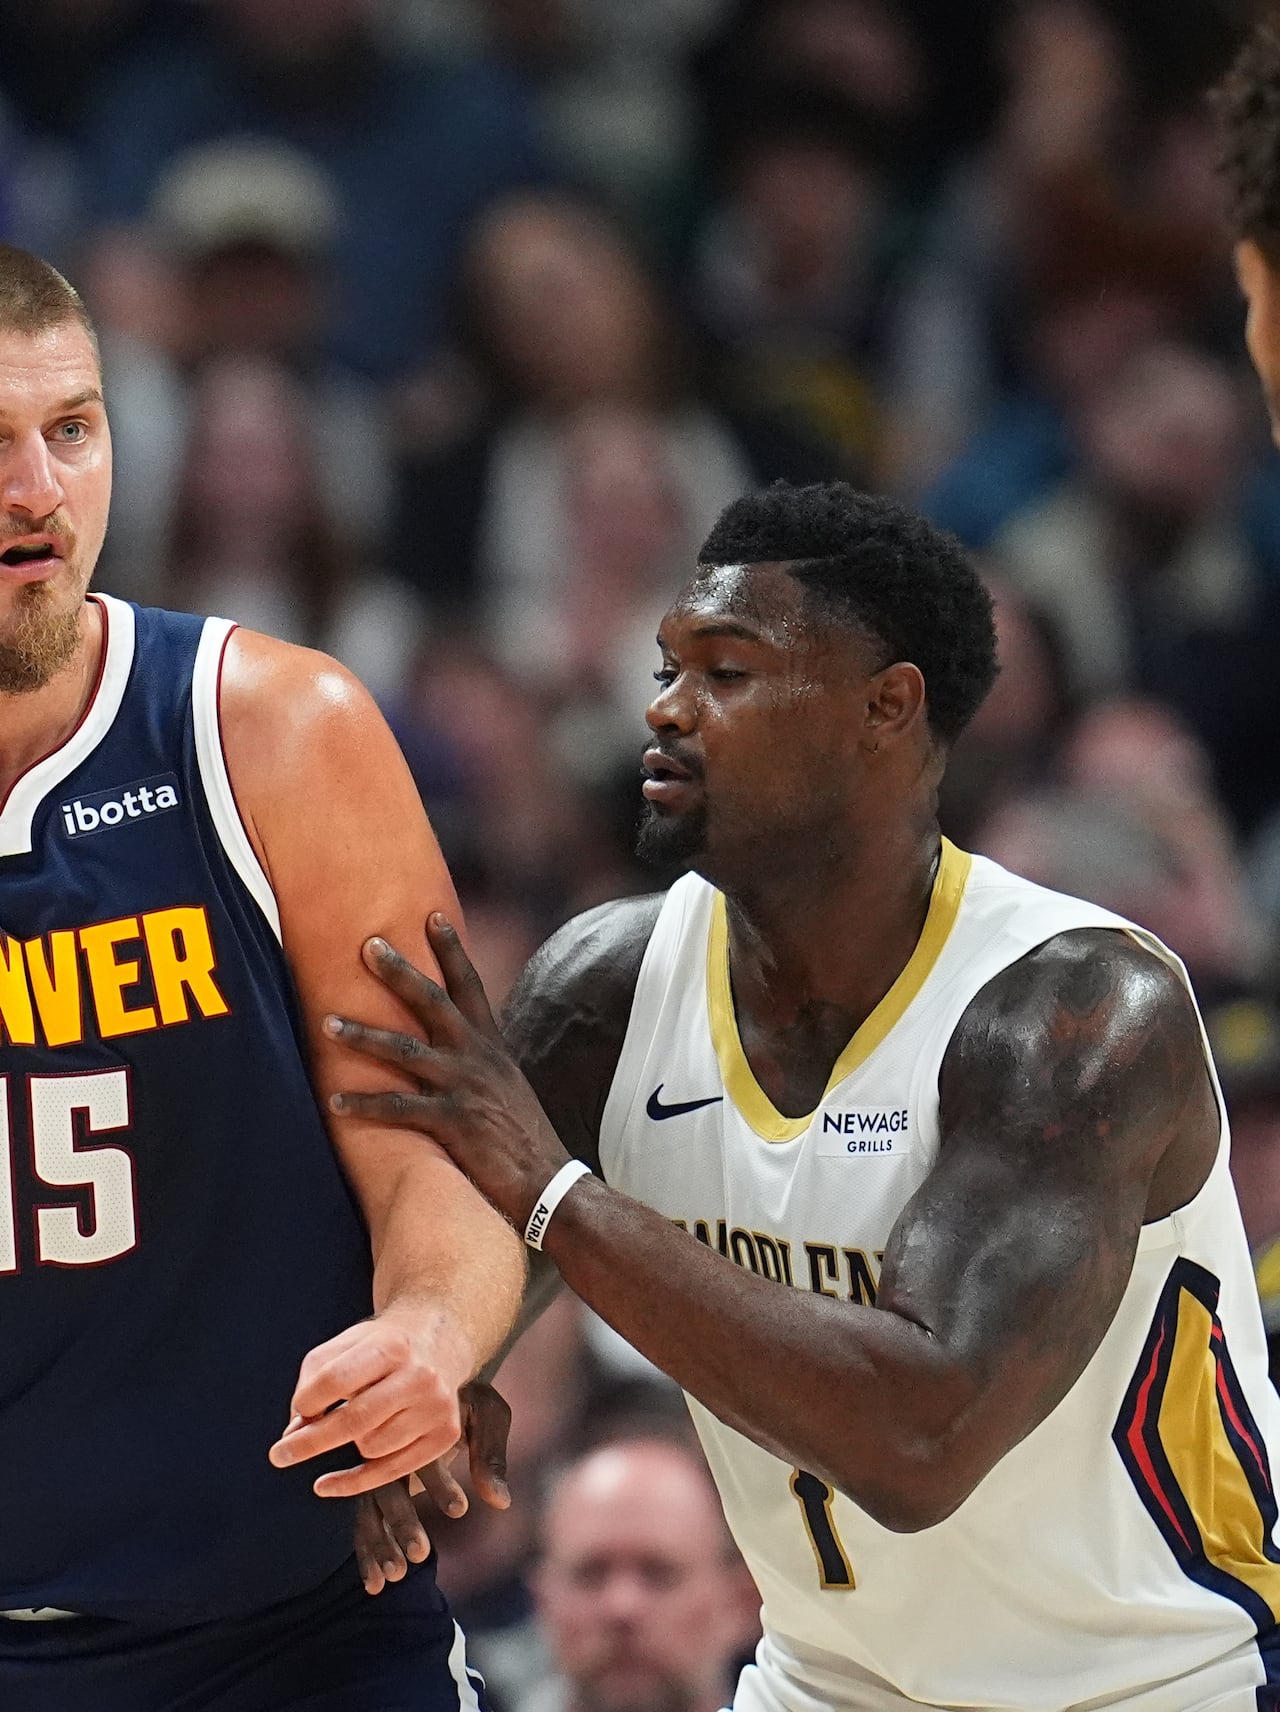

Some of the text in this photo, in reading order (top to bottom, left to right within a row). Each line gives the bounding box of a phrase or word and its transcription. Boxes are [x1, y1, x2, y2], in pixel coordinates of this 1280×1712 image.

[62, 784, 179, 835] ibotta
[823, 1110, 908, 1134] NEWAGE
[847, 1139, 892, 1153] GRILLS
